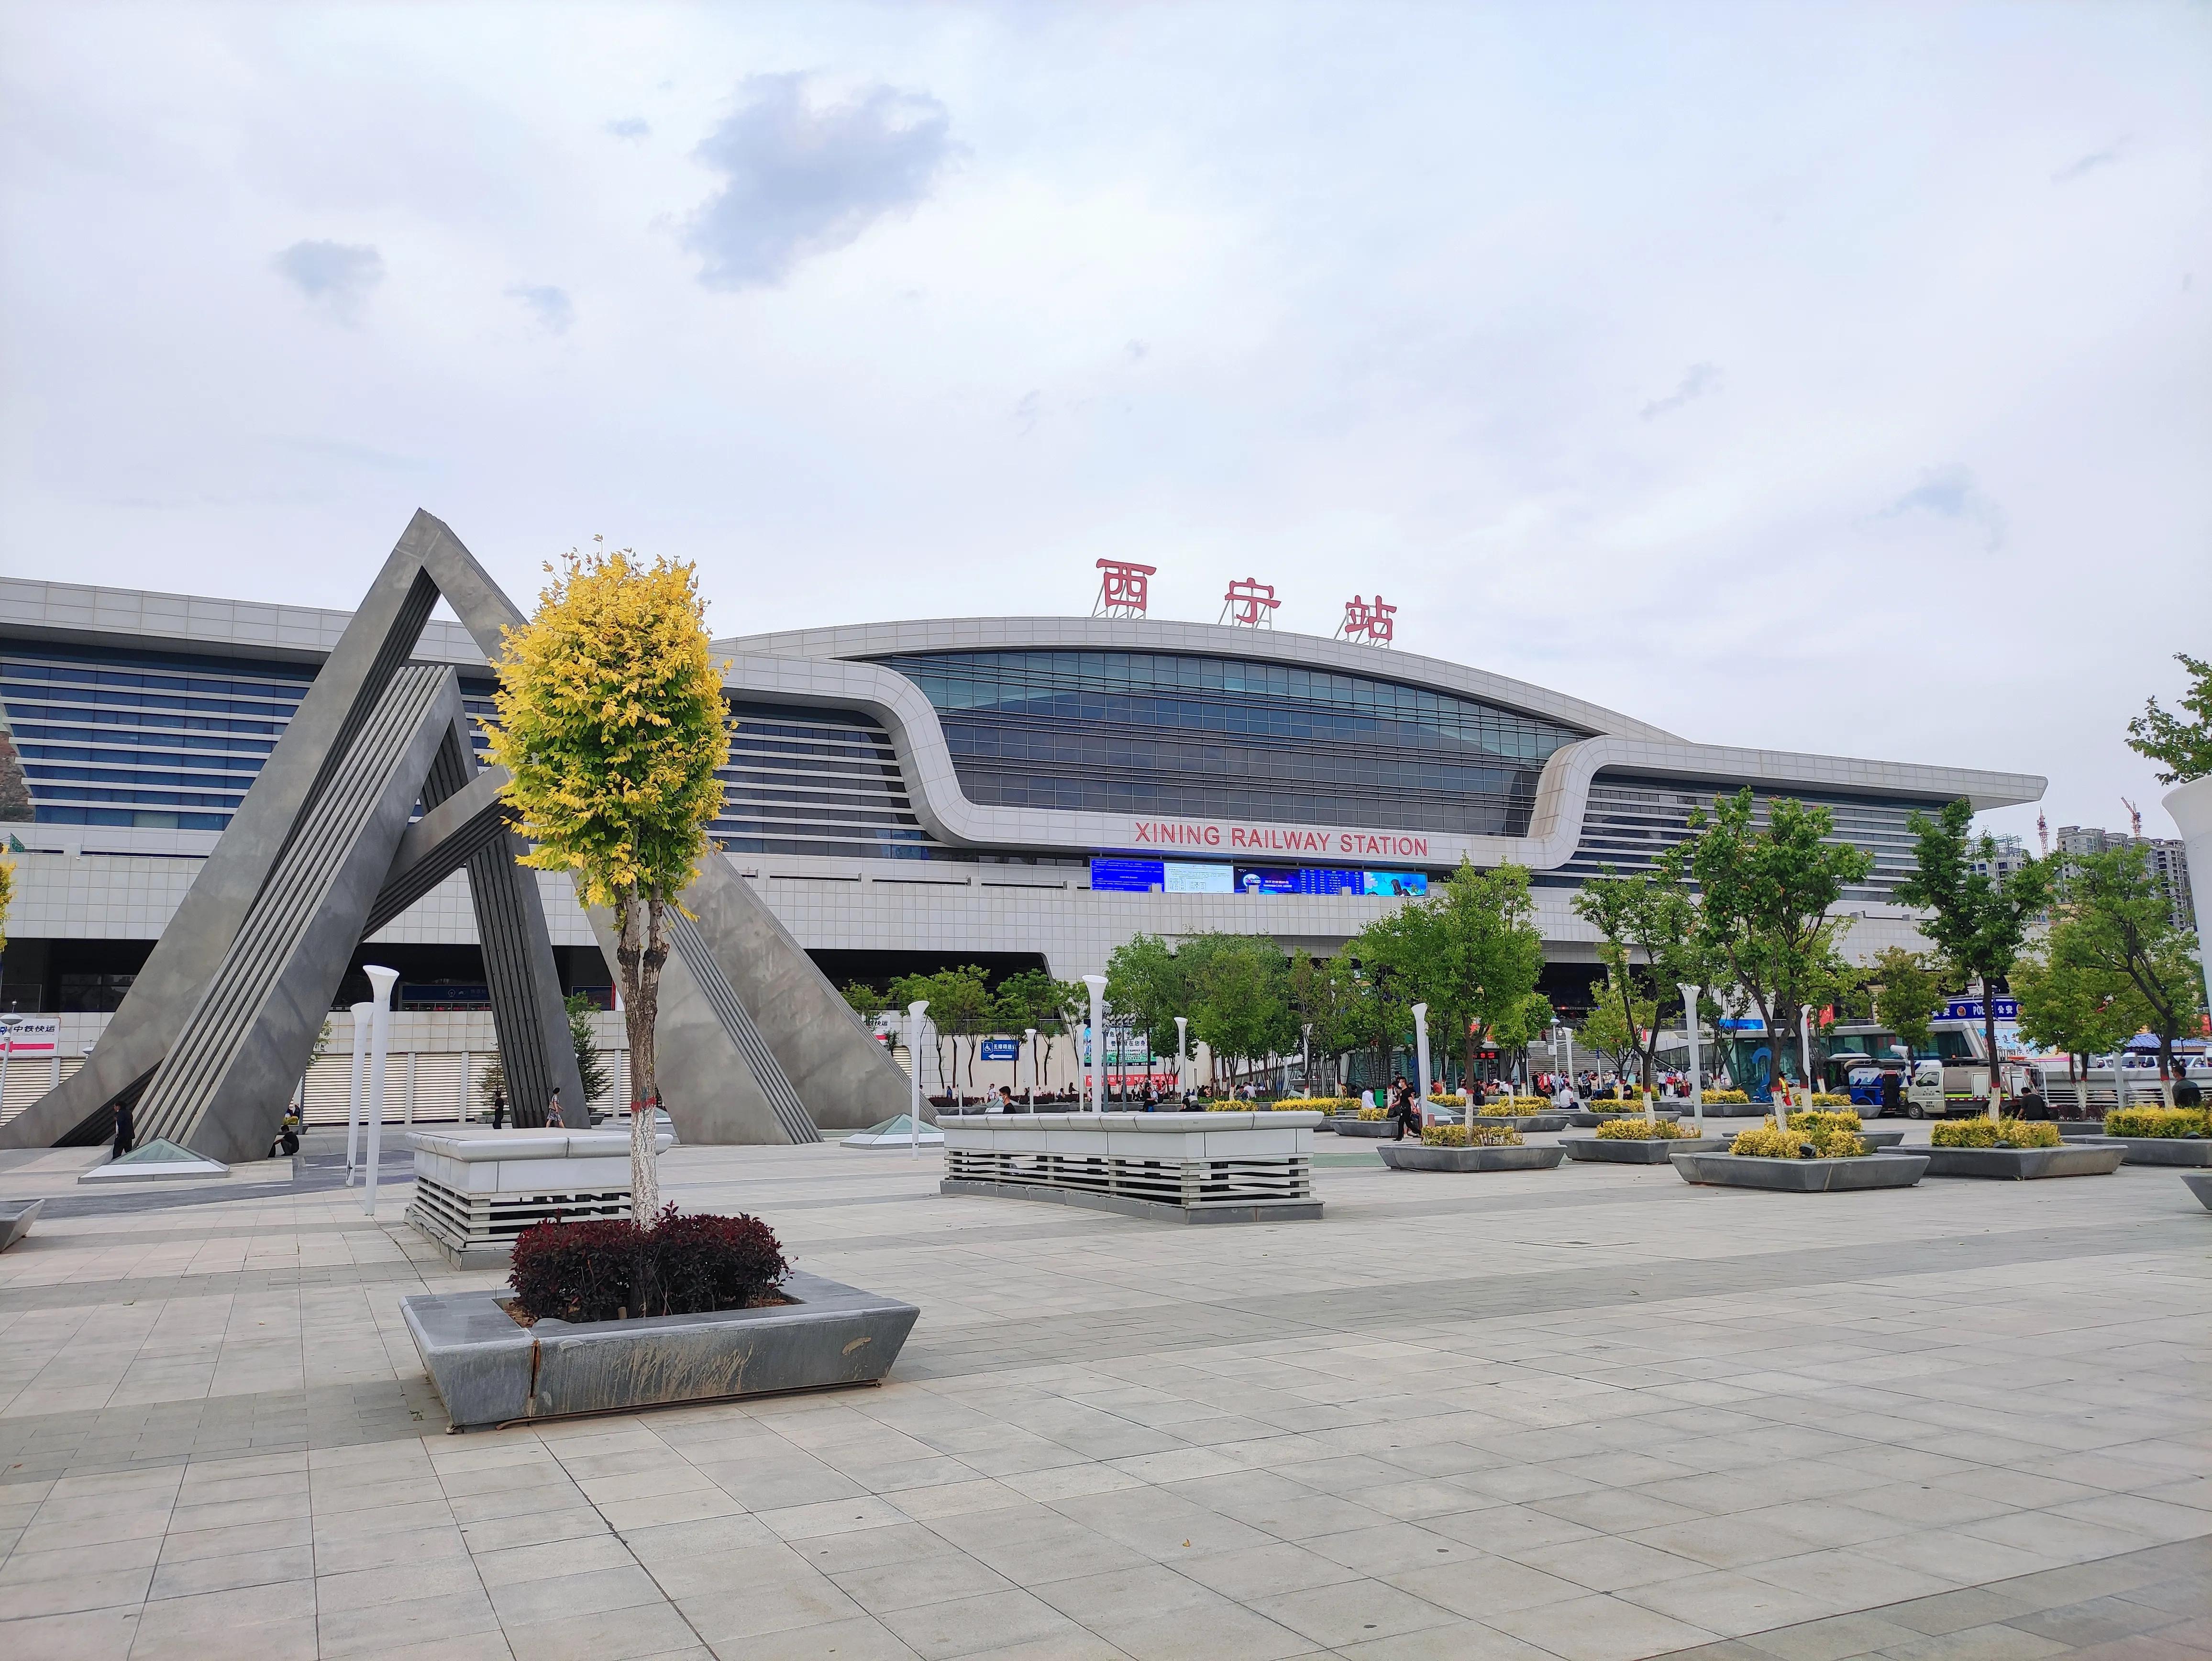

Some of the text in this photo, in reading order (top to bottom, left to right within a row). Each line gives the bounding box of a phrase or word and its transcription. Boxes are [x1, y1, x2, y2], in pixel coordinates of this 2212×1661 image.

[1096, 558, 1397, 641] 西宁站
[1135, 822, 1427, 856] XINING RAILWAY STATION
[1973, 1006, 1994, 1015] POL
[1997, 1005, 2013, 1014] 公安
